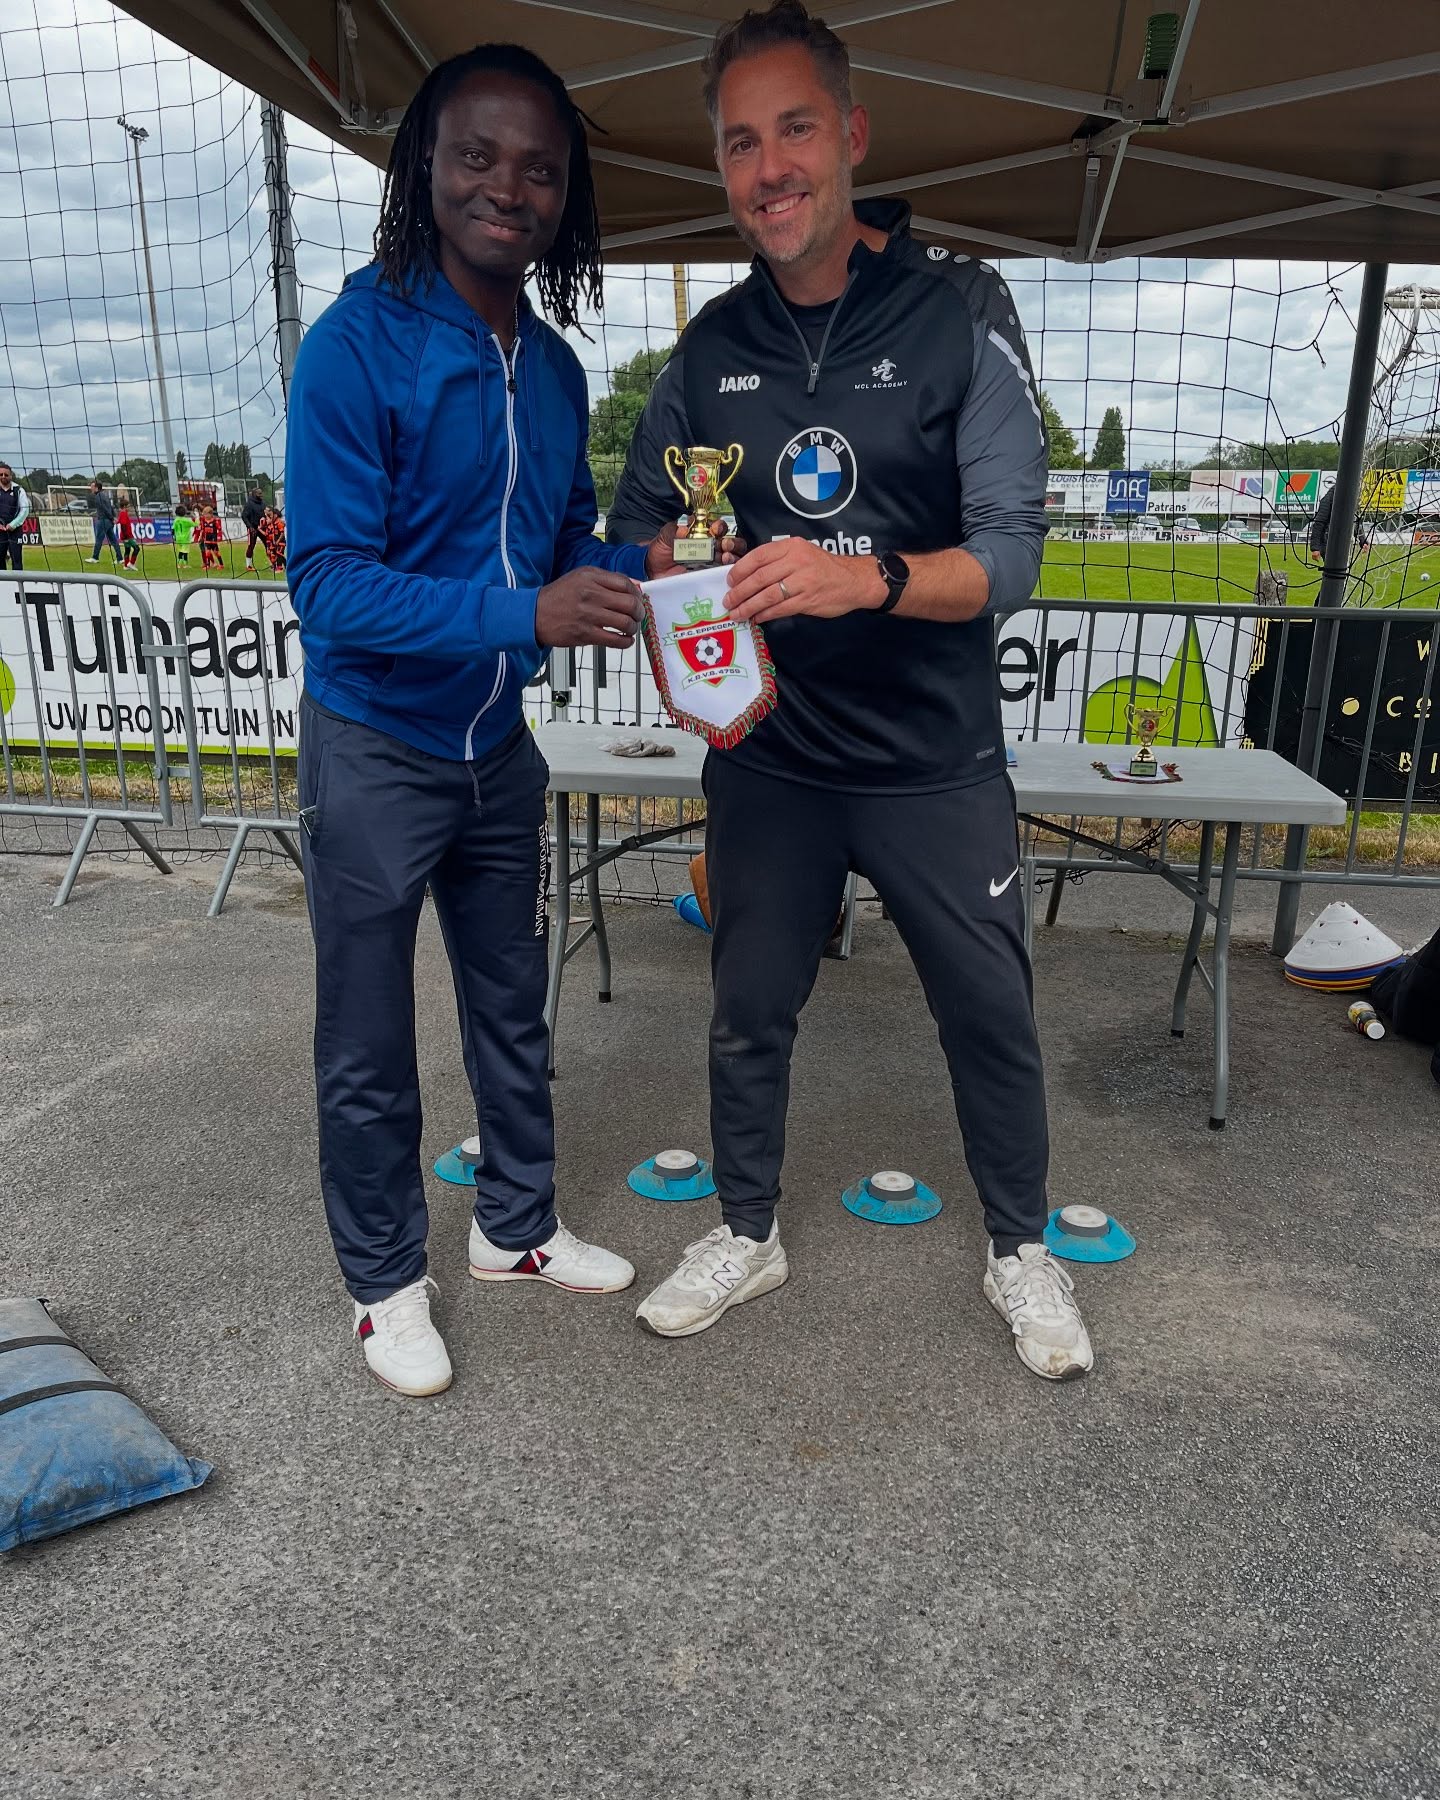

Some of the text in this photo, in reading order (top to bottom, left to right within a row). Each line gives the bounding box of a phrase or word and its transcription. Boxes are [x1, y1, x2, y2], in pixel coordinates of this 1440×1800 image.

[718, 374, 761, 393] JAKO
[854, 380, 908, 390] MCL ACADEMY
[787, 431, 846, 460] BMW
[1147, 501, 1187, 512] Patrans
[771, 531, 872, 556] ghe
[1173, 534, 1197, 542] NST
[673, 629, 696, 639] K.F.C.
[45, 702, 88, 731] UW
[97, 703, 261, 737] DROOMTUIN
